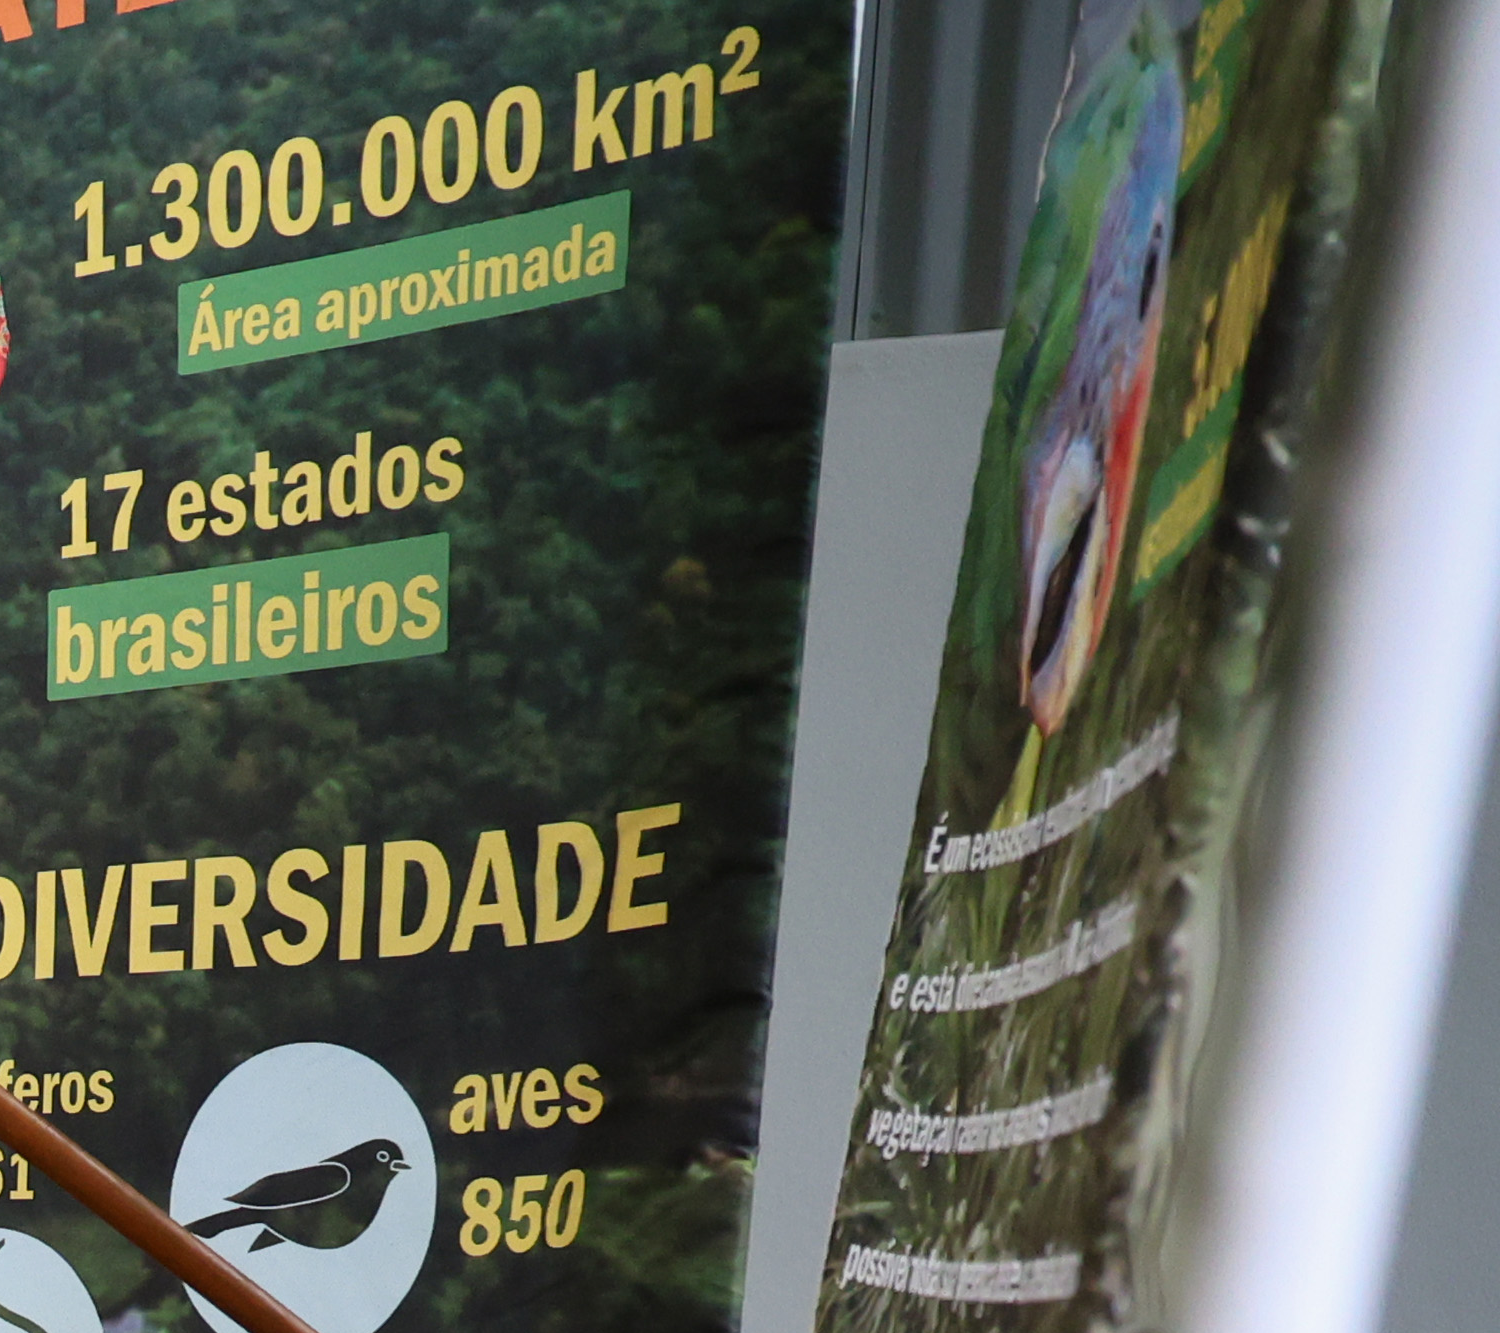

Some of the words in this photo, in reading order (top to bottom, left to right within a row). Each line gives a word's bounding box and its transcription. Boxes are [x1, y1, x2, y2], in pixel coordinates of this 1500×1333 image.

[73, 85, 543, 278] 1.300.000
[187, 282, 301, 356] Área
[315, 224, 617, 338] aproximada
[60, 469, 144, 559] 17
[166, 431, 465, 542] estados
[55, 570, 442, 684] brasileiros
[449, 1063, 604, 1134] aves
[459, 1168, 586, 1257] 850
